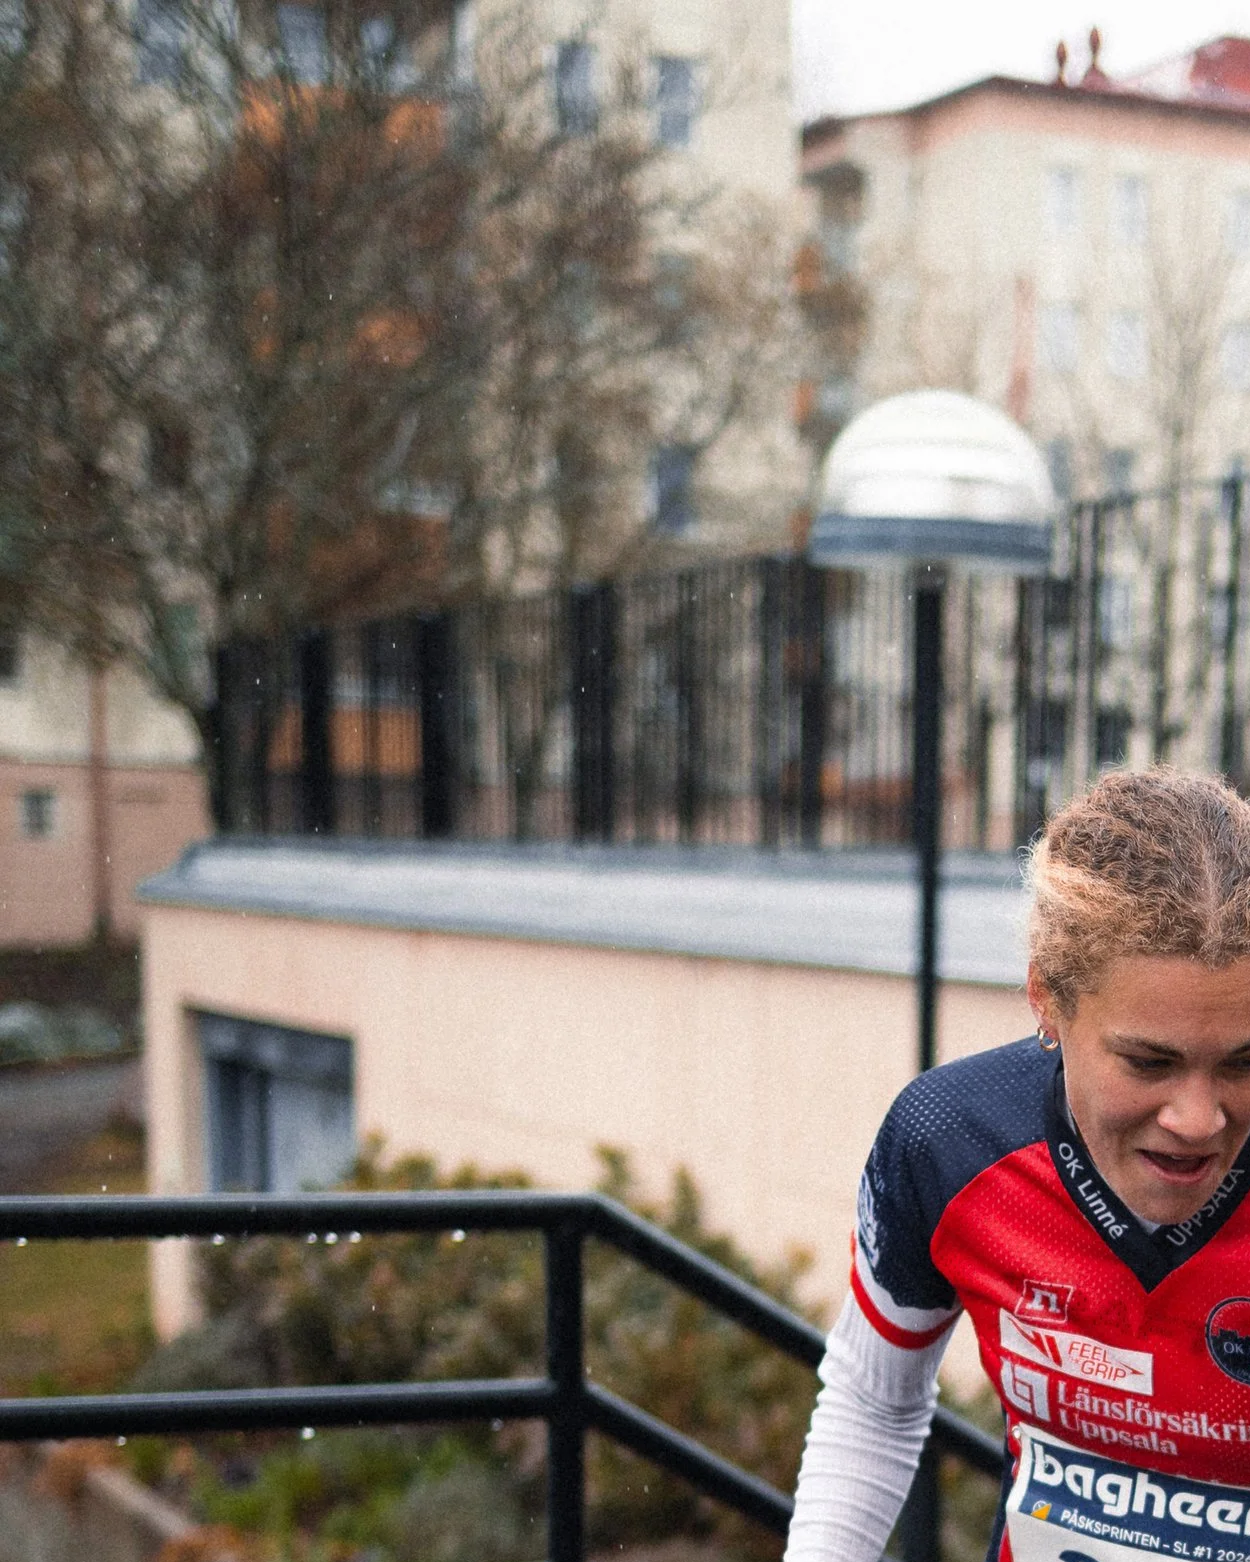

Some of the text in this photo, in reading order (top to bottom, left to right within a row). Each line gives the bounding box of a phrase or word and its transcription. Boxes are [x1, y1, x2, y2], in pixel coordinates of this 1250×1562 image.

[1058, 1142, 1130, 1240] OK Linné
[1165, 1167, 1245, 1247] UPPSALA
[1068, 1340, 1112, 1365] FEEL
[1080, 1359, 1128, 1382] GRIP
[1223, 1341, 1244, 1354] OK
[1058, 1409, 1179, 1457] Uppsala
[1060, 1507, 1161, 1549] PÅSKSPRINTEN
[1173, 1540, 1190, 1556] SL
[1193, 1544, 1212, 1560] #1
